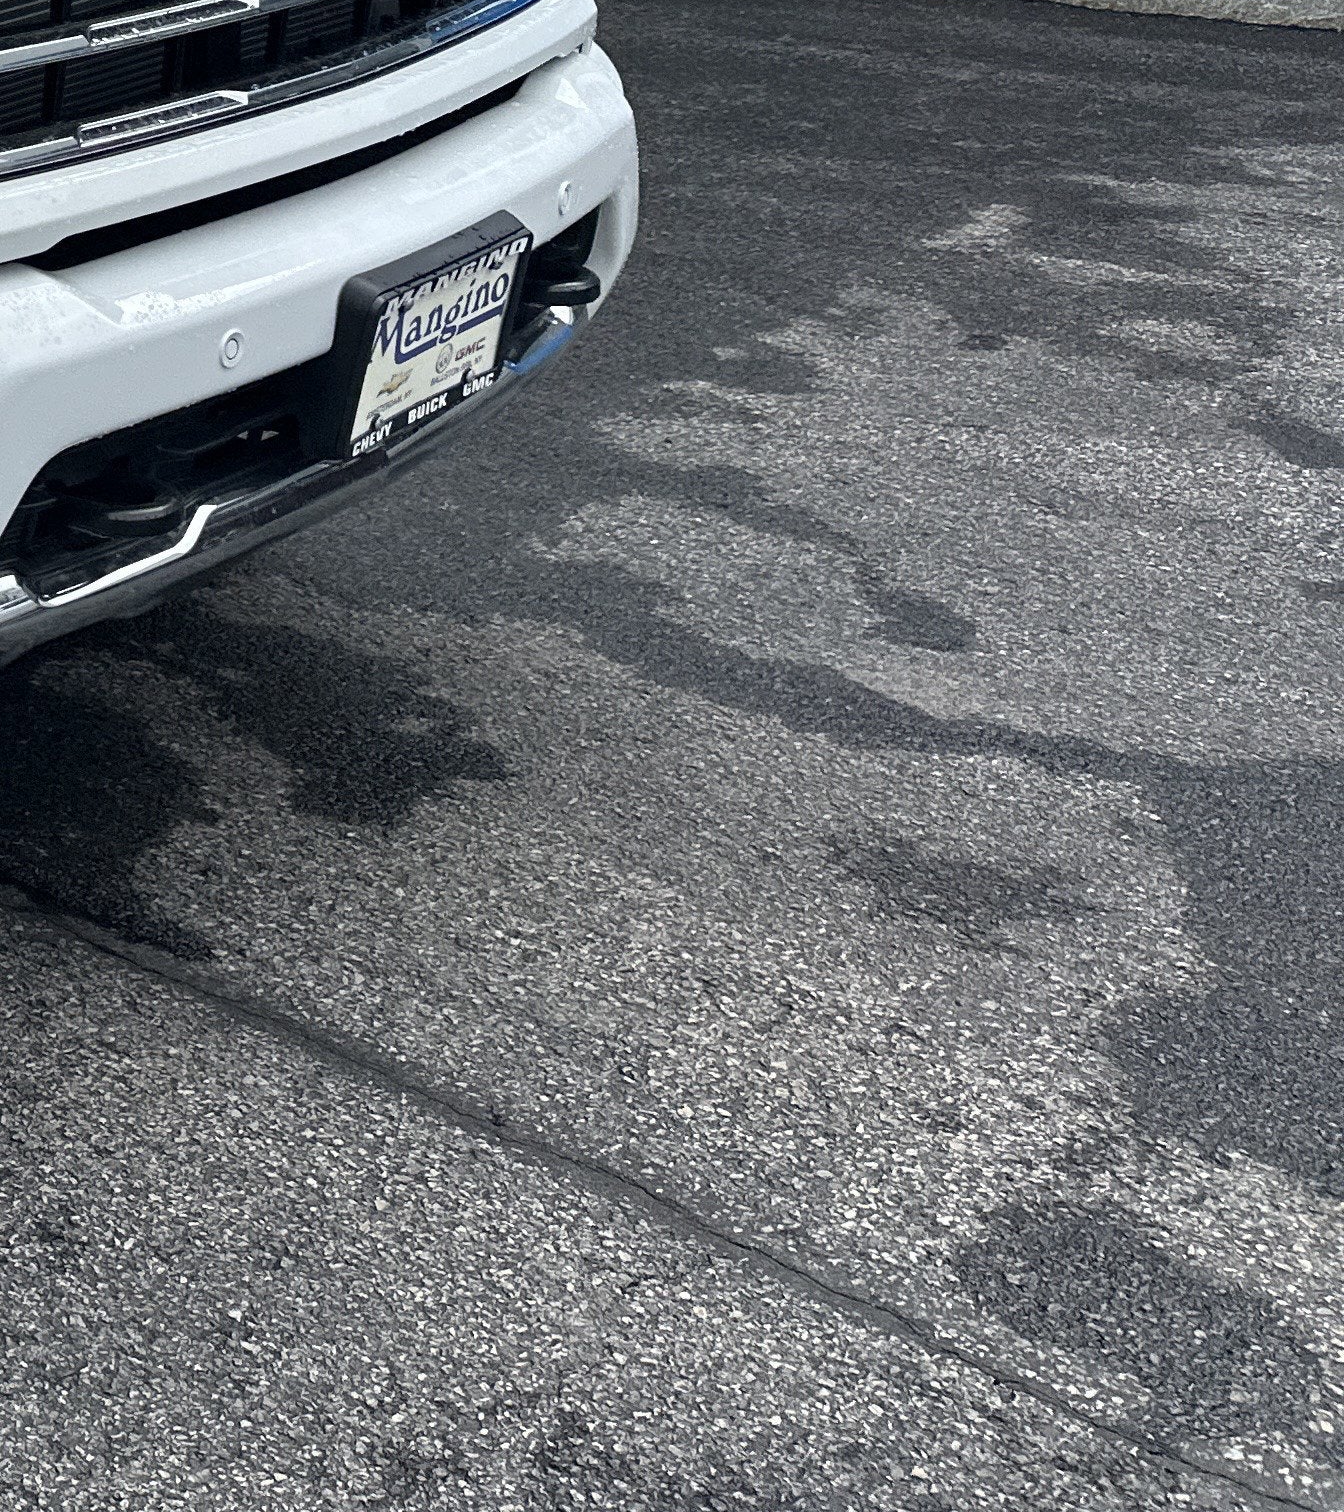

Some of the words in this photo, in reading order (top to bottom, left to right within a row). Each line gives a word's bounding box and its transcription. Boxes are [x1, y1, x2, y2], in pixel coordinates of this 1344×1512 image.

[372, 272, 510, 360] Mangino
[352, 421, 393, 457] CHEVY
[408, 392, 448, 425] BUICK
[462, 372, 495, 397] GMC
